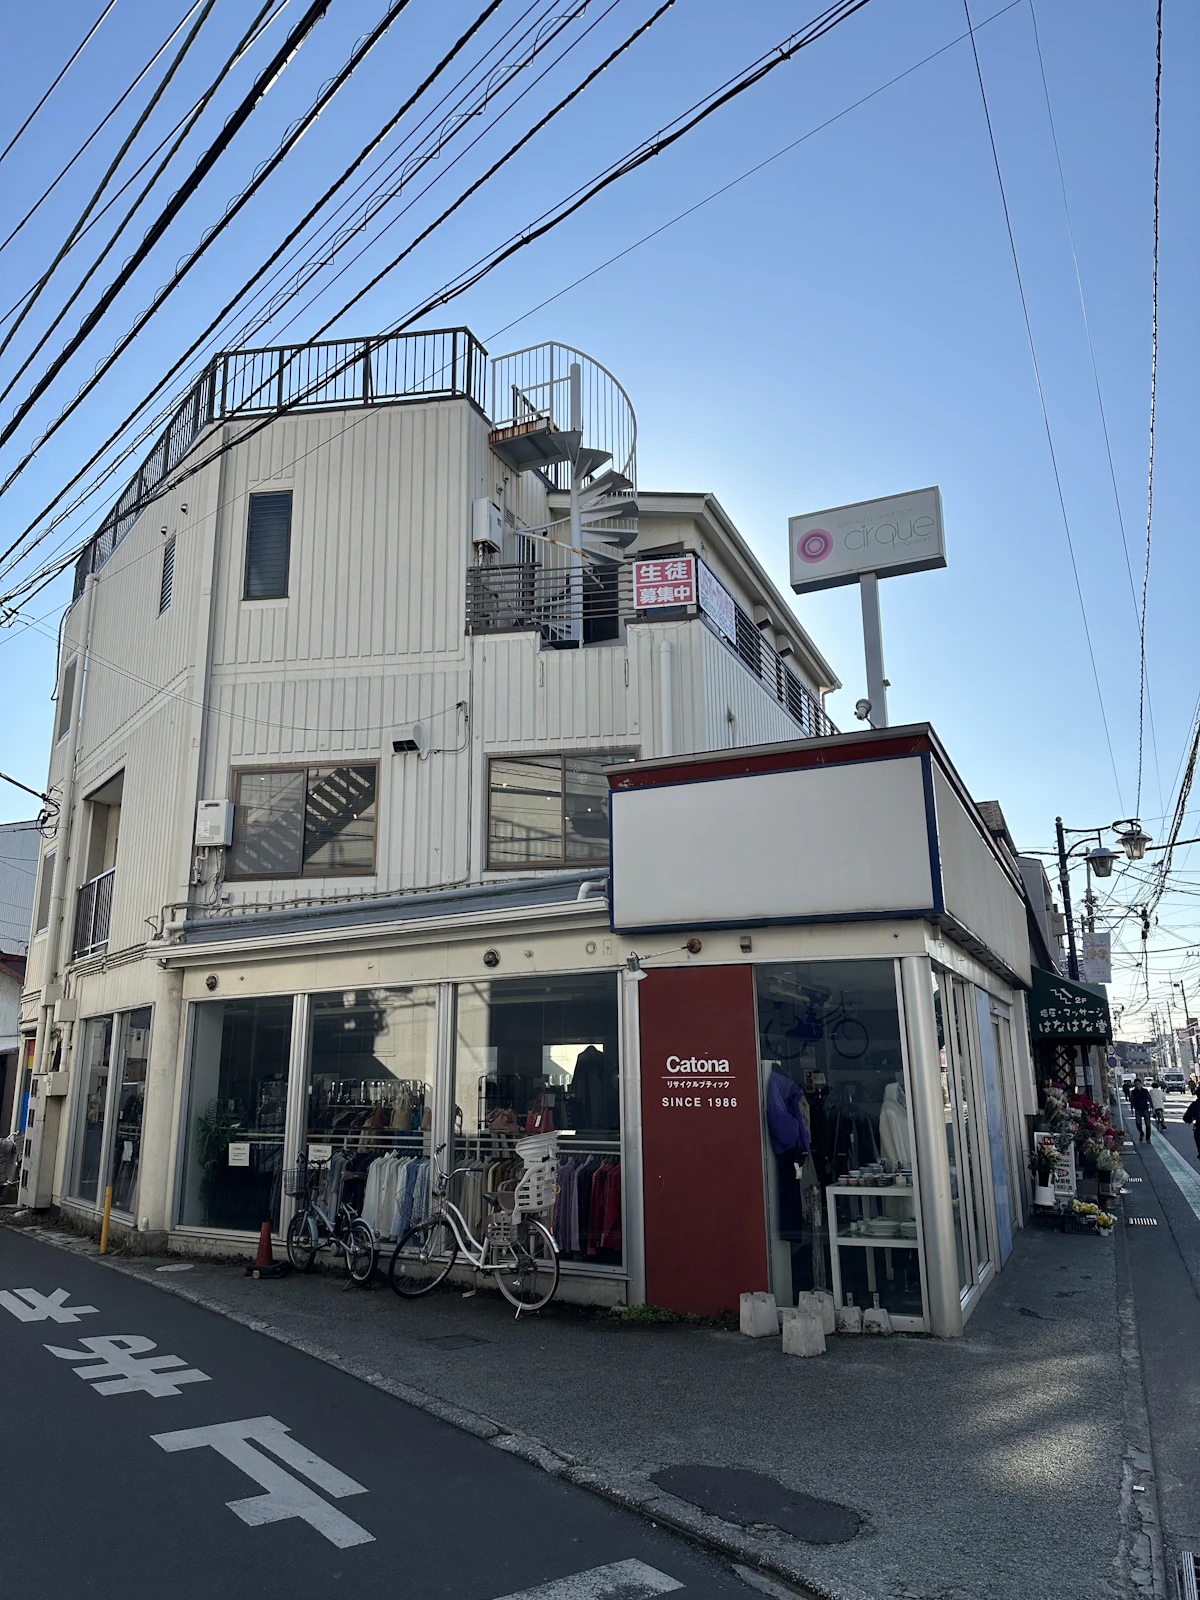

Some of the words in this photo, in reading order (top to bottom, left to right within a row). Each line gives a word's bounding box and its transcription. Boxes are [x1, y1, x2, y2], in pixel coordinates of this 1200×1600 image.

[844, 515, 935, 551] cirque
[639, 561, 688, 582] 生徒
[639, 584, 691, 604] 募集中
[1074, 996, 1088, 1004] 2F
[1039, 1006, 1104, 1018] 指圧・マッサージ
[1038, 1019, 1108, 1034] はなはな堂
[666, 1055, 730, 1073] Catona
[666, 1080, 731, 1089] リサイクルブティック
[661, 1096, 702, 1107] SINCE
[707, 1096, 738, 1107] 1986
